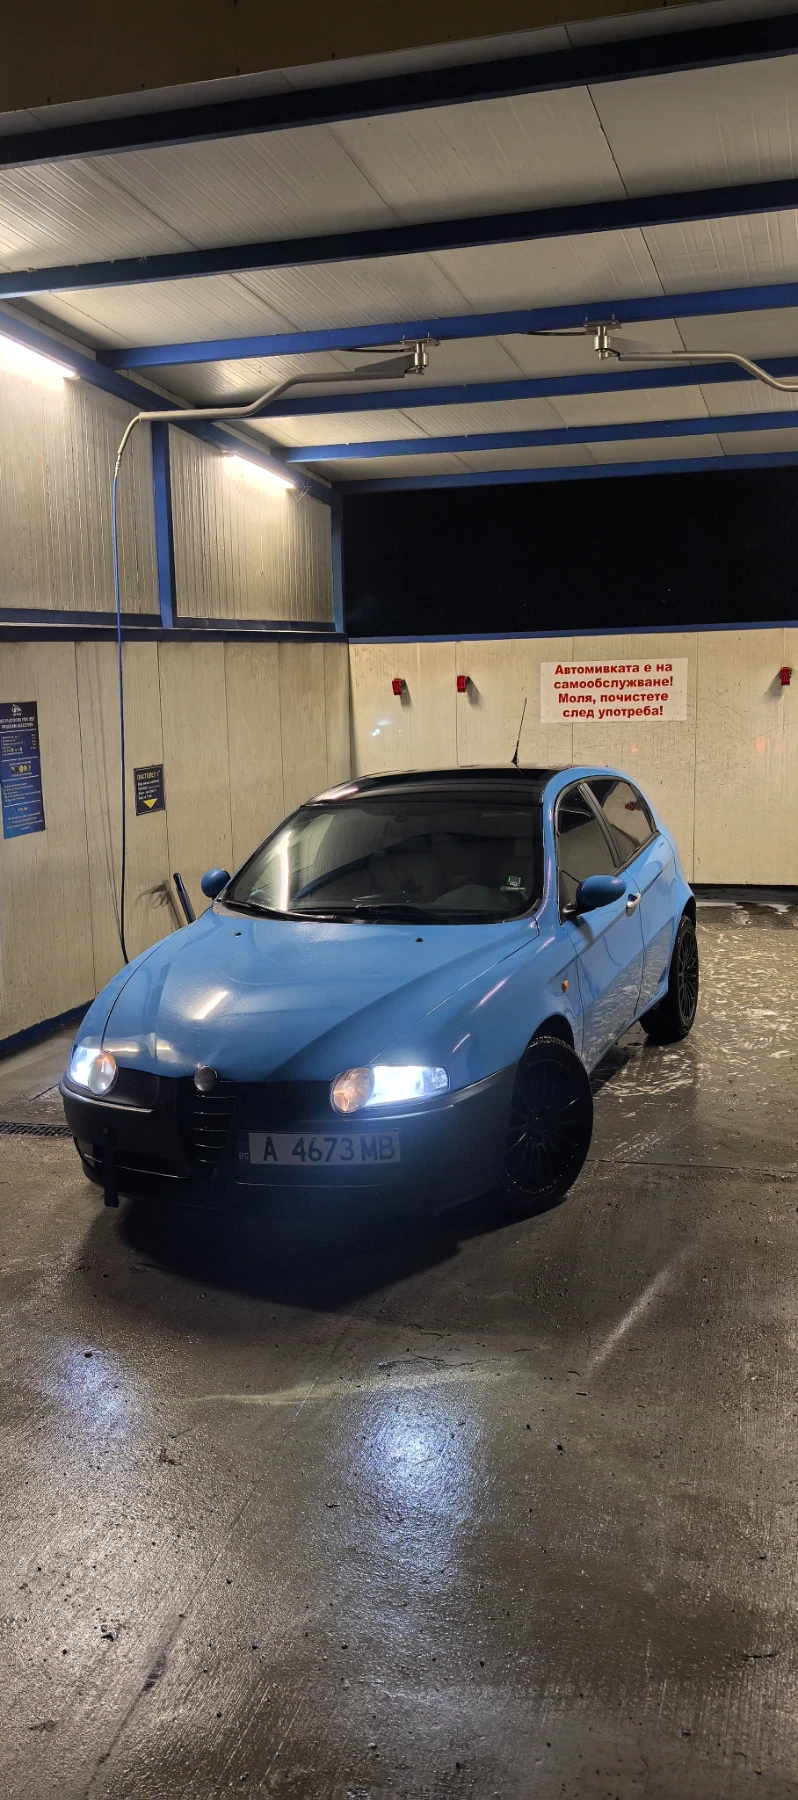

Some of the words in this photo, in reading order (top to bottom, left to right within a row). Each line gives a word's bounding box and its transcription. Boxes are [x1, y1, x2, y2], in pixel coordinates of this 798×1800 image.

[555, 664, 640, 675] Автомивката
[644, 664, 652, 672] е
[656, 663, 673, 672] на
[554, 676, 673, 690] самообслужване!
[558, 693, 596, 705] Моля,
[600, 692, 669, 703] почистете
[563, 708, 595, 719] след
[598, 705, 663, 719] употреба!
[263, 1136, 278, 1162] A
[292, 1136, 355, 1162] 4673
[360, 1134, 395, 1161] MB
[238, 1152, 249, 1160] BG
